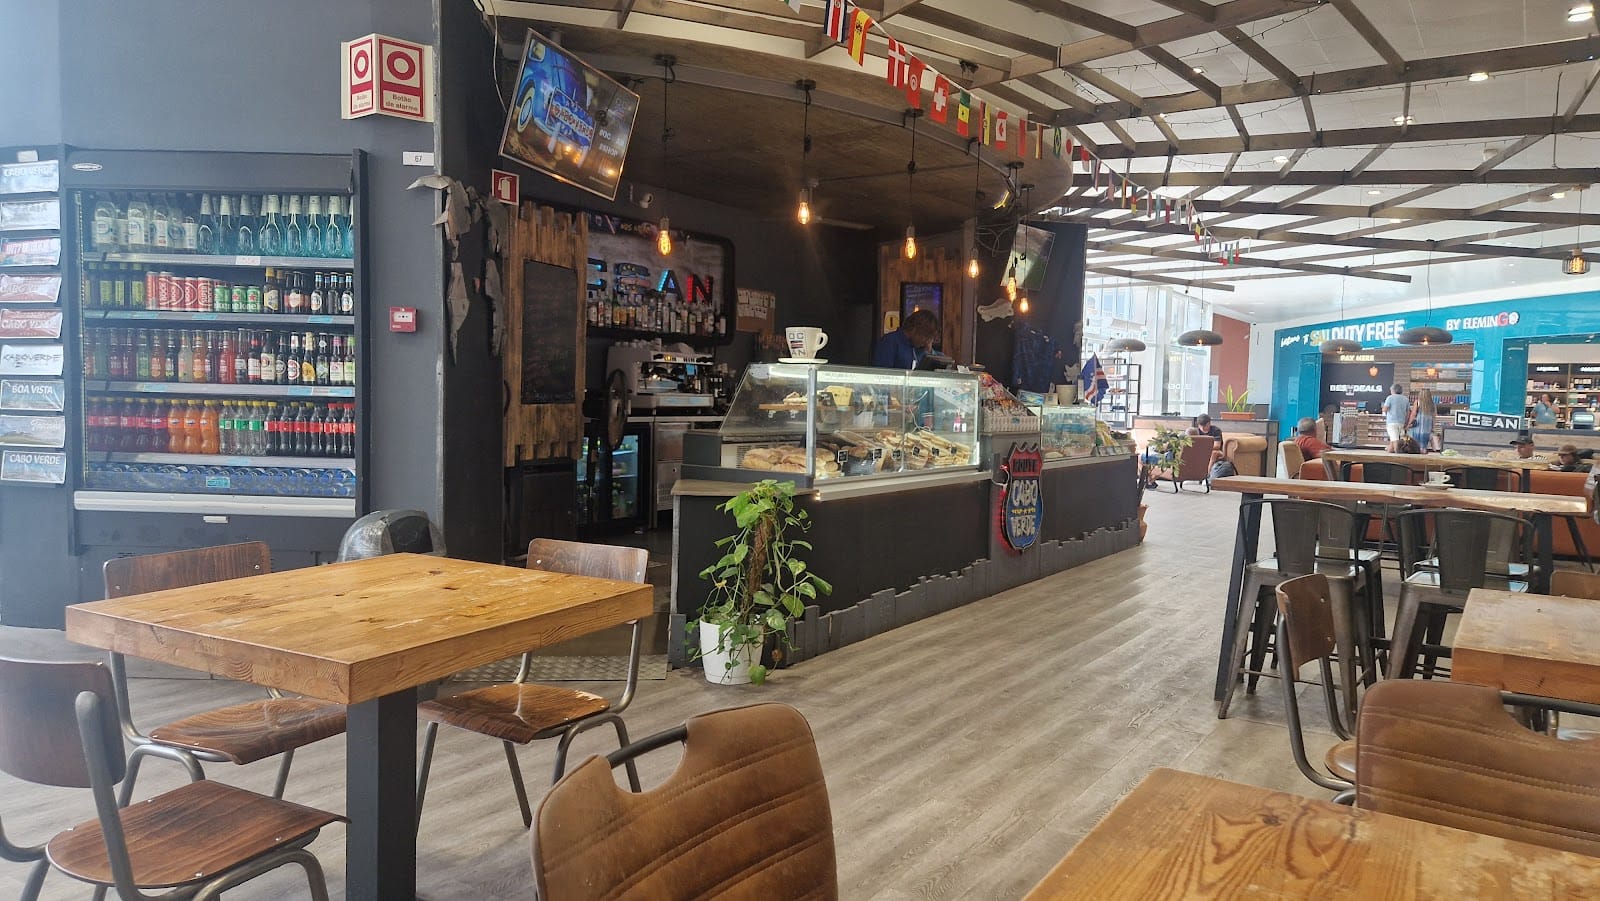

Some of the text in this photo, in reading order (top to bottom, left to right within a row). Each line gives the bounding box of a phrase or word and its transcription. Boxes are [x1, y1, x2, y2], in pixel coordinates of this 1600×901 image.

[1366, 319, 1406, 341] FREE
[1446, 318, 1461, 331] BY
[12, 385, 53, 394] BOA VISTA
[1354, 384, 1383, 393] DEALS
[1457, 414, 1518, 430] OCEAN
[10, 454, 61, 465] CABO VERDE
[1012, 479, 1038, 507] CABO
[1010, 514, 1037, 538] VERDE
